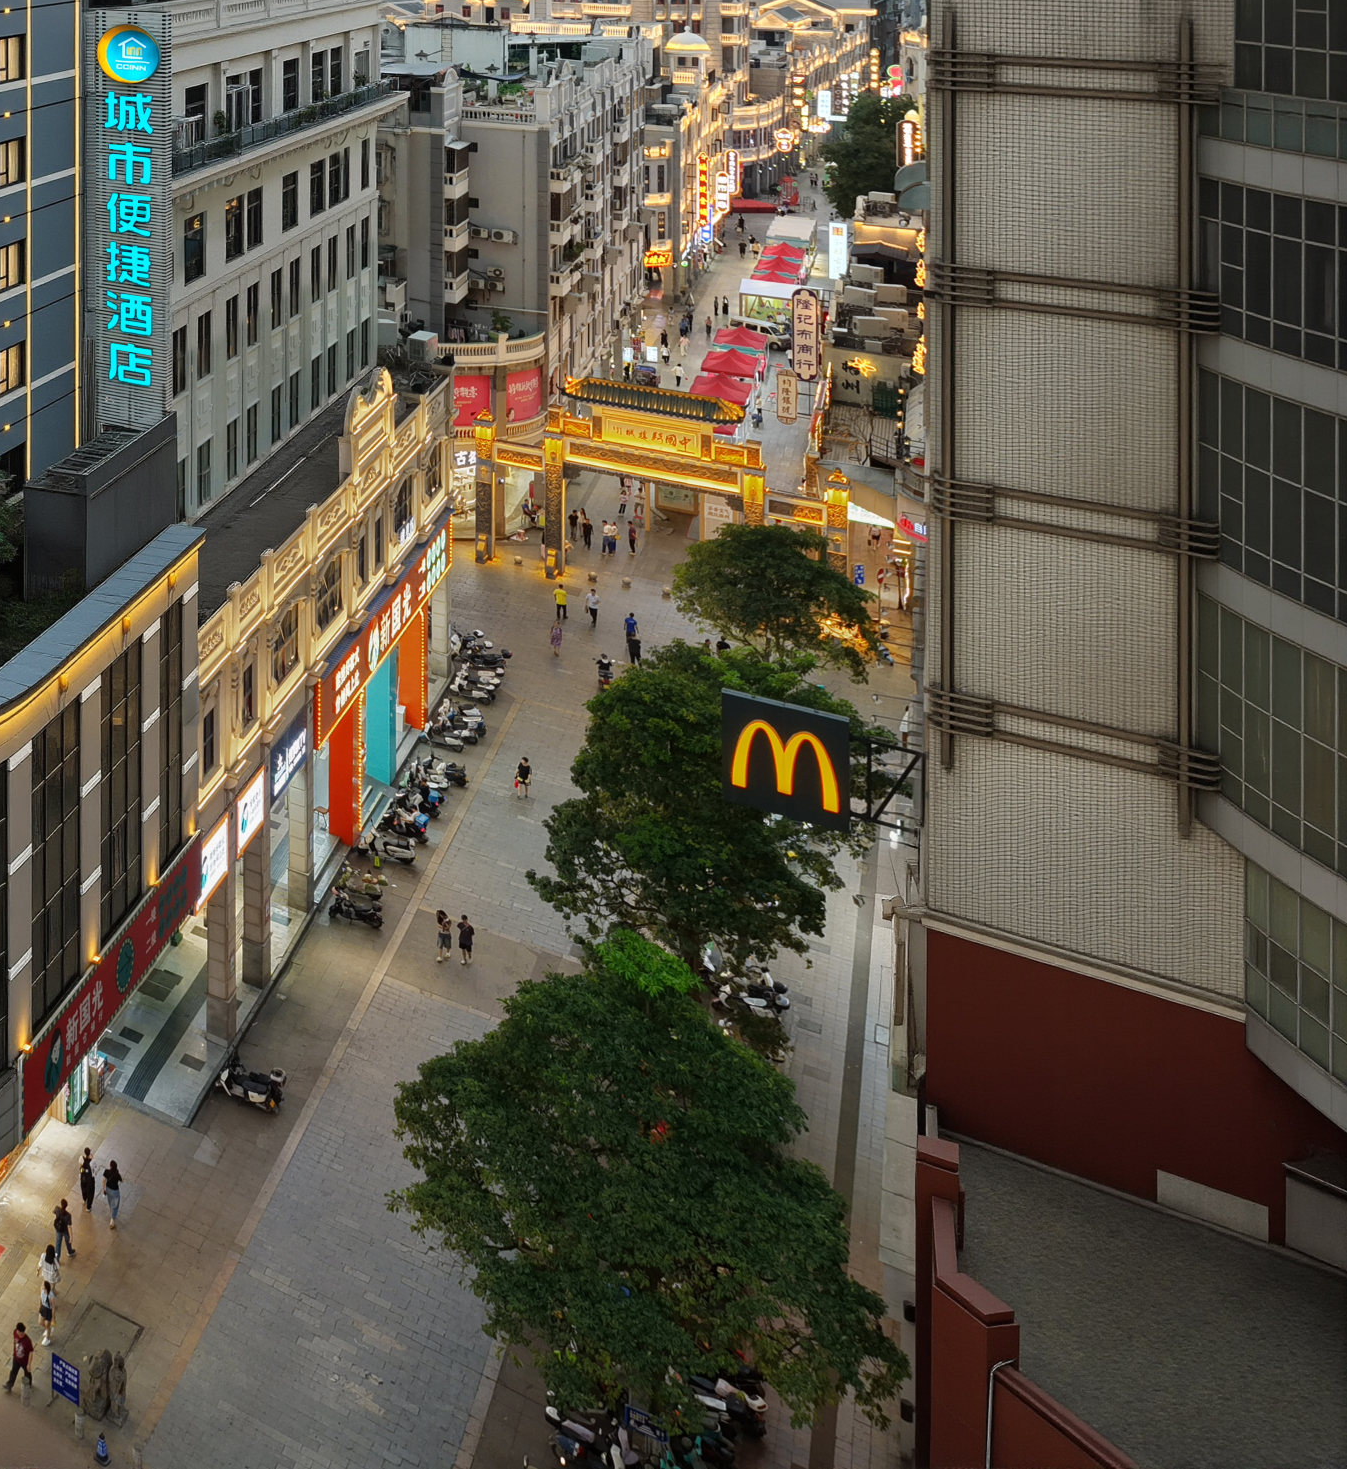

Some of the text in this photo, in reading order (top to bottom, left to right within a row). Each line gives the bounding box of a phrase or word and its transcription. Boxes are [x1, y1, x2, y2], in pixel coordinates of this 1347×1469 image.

[116, 63, 146, 71] CCINN
[104, 90, 154, 387] 城市便捷酒店
[65, 980, 104, 1052] 新国光
